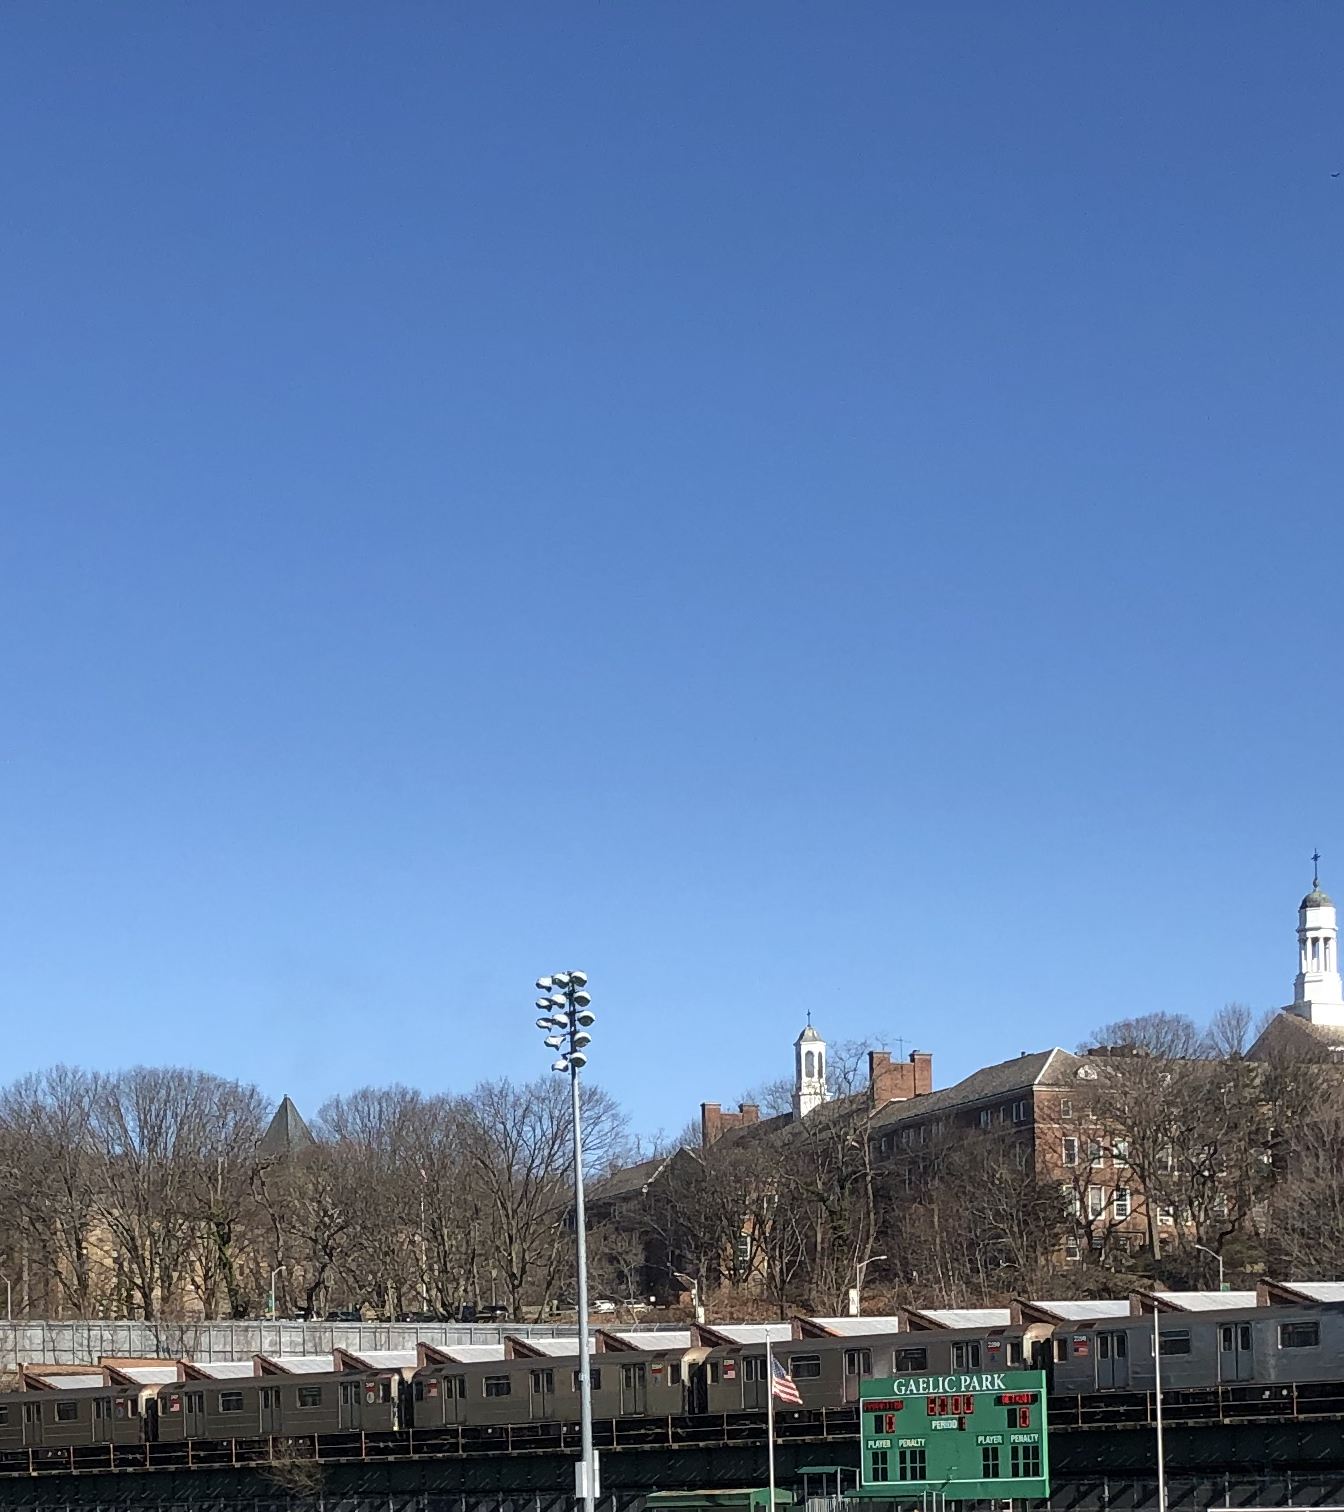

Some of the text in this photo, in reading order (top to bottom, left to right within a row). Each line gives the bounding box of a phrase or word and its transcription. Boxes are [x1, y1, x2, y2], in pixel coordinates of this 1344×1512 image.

[893, 1373, 1006, 1395] GAELIC PARK
[1020, 1408, 1029, 1427] 0
[886, 1414, 895, 1433] 0
[931, 1420, 958, 1430] PERIOD
[898, 1438, 926, 1448] PENALTY
[977, 1435, 1003, 1444] PLAYER
[1010, 1434, 1039, 1443] PENALTY
[867, 1440, 892, 1448] PLAYER
